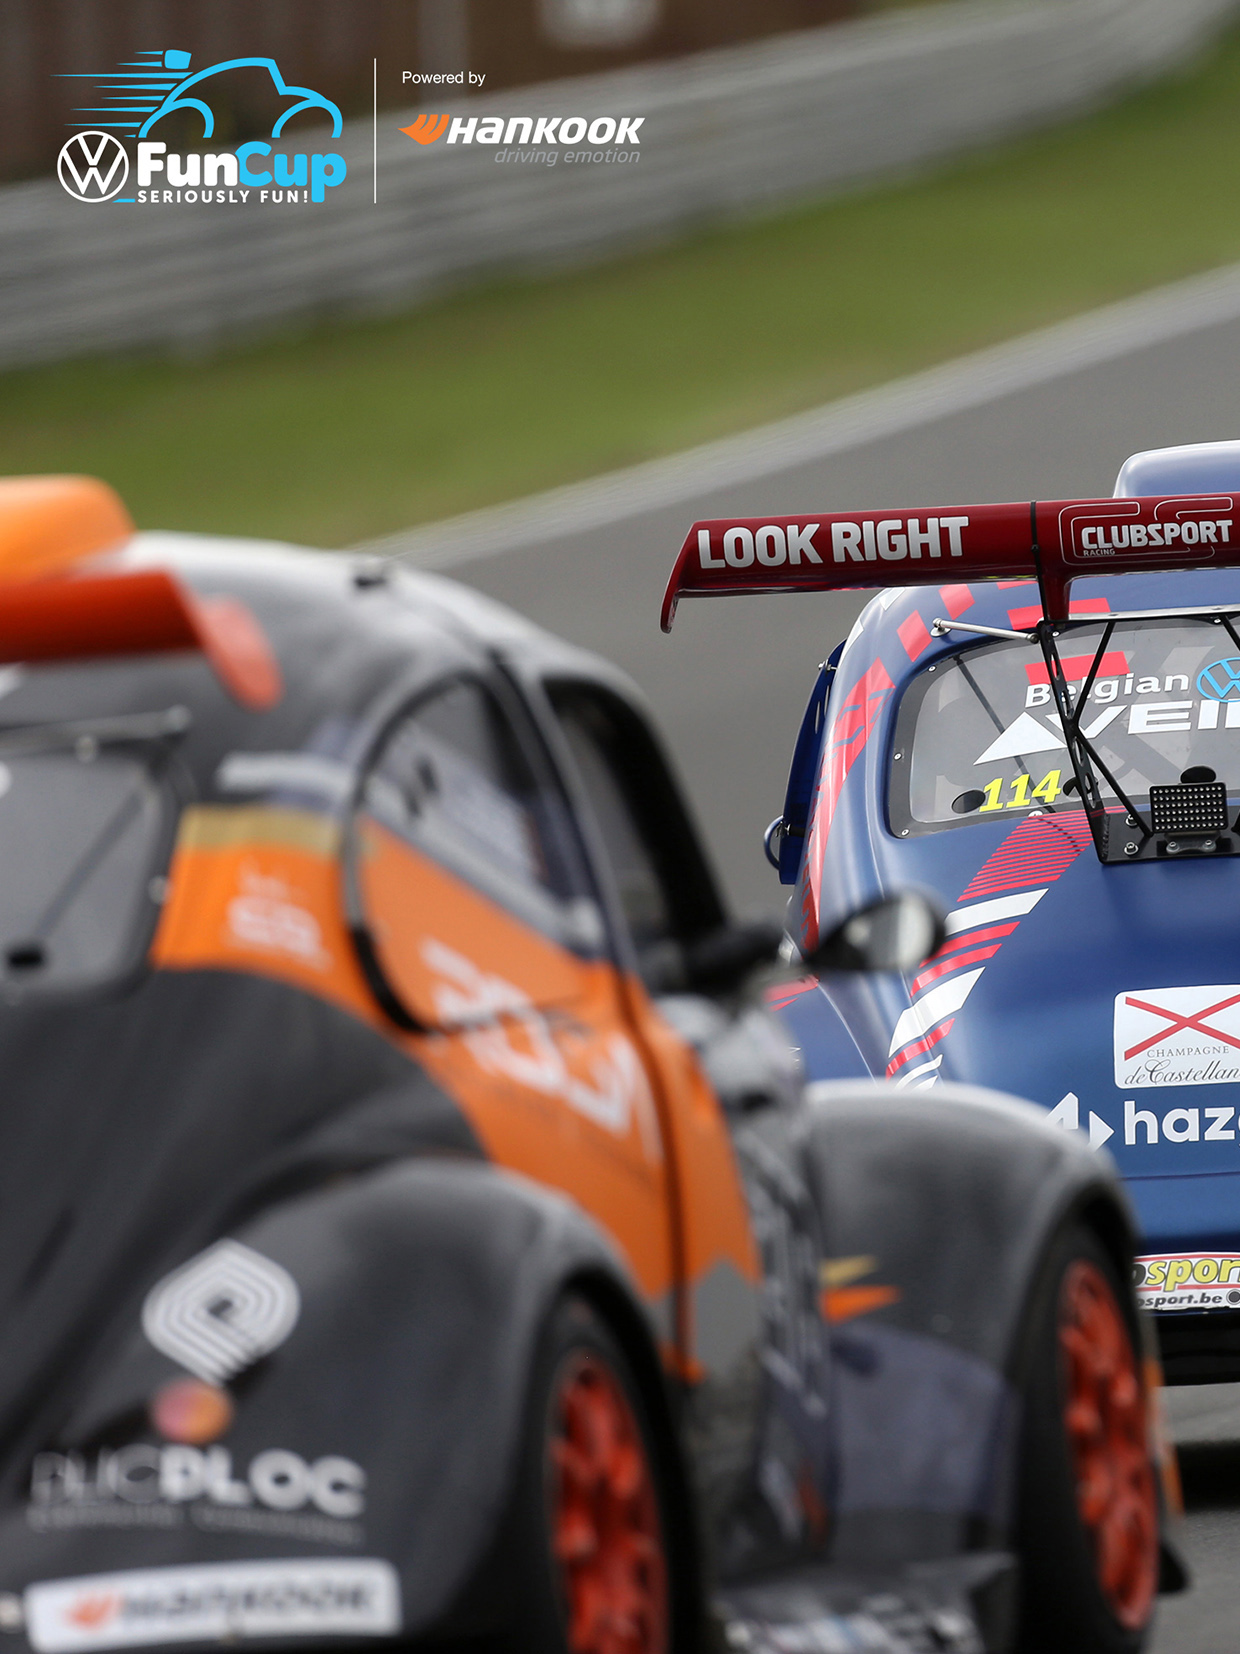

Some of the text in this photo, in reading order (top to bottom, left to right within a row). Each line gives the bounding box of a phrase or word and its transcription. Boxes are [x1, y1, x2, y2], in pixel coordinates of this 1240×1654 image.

[698, 516, 969, 569] LOOK RIGHT
[1081, 519, 1233, 549] CLUBSPORT
[1083, 548, 1116, 557] RACING
[978, 769, 1062, 812] 114
[1147, 1046, 1229, 1058] CHAMPAGNE
[1124, 1066, 1147, 1085] de
